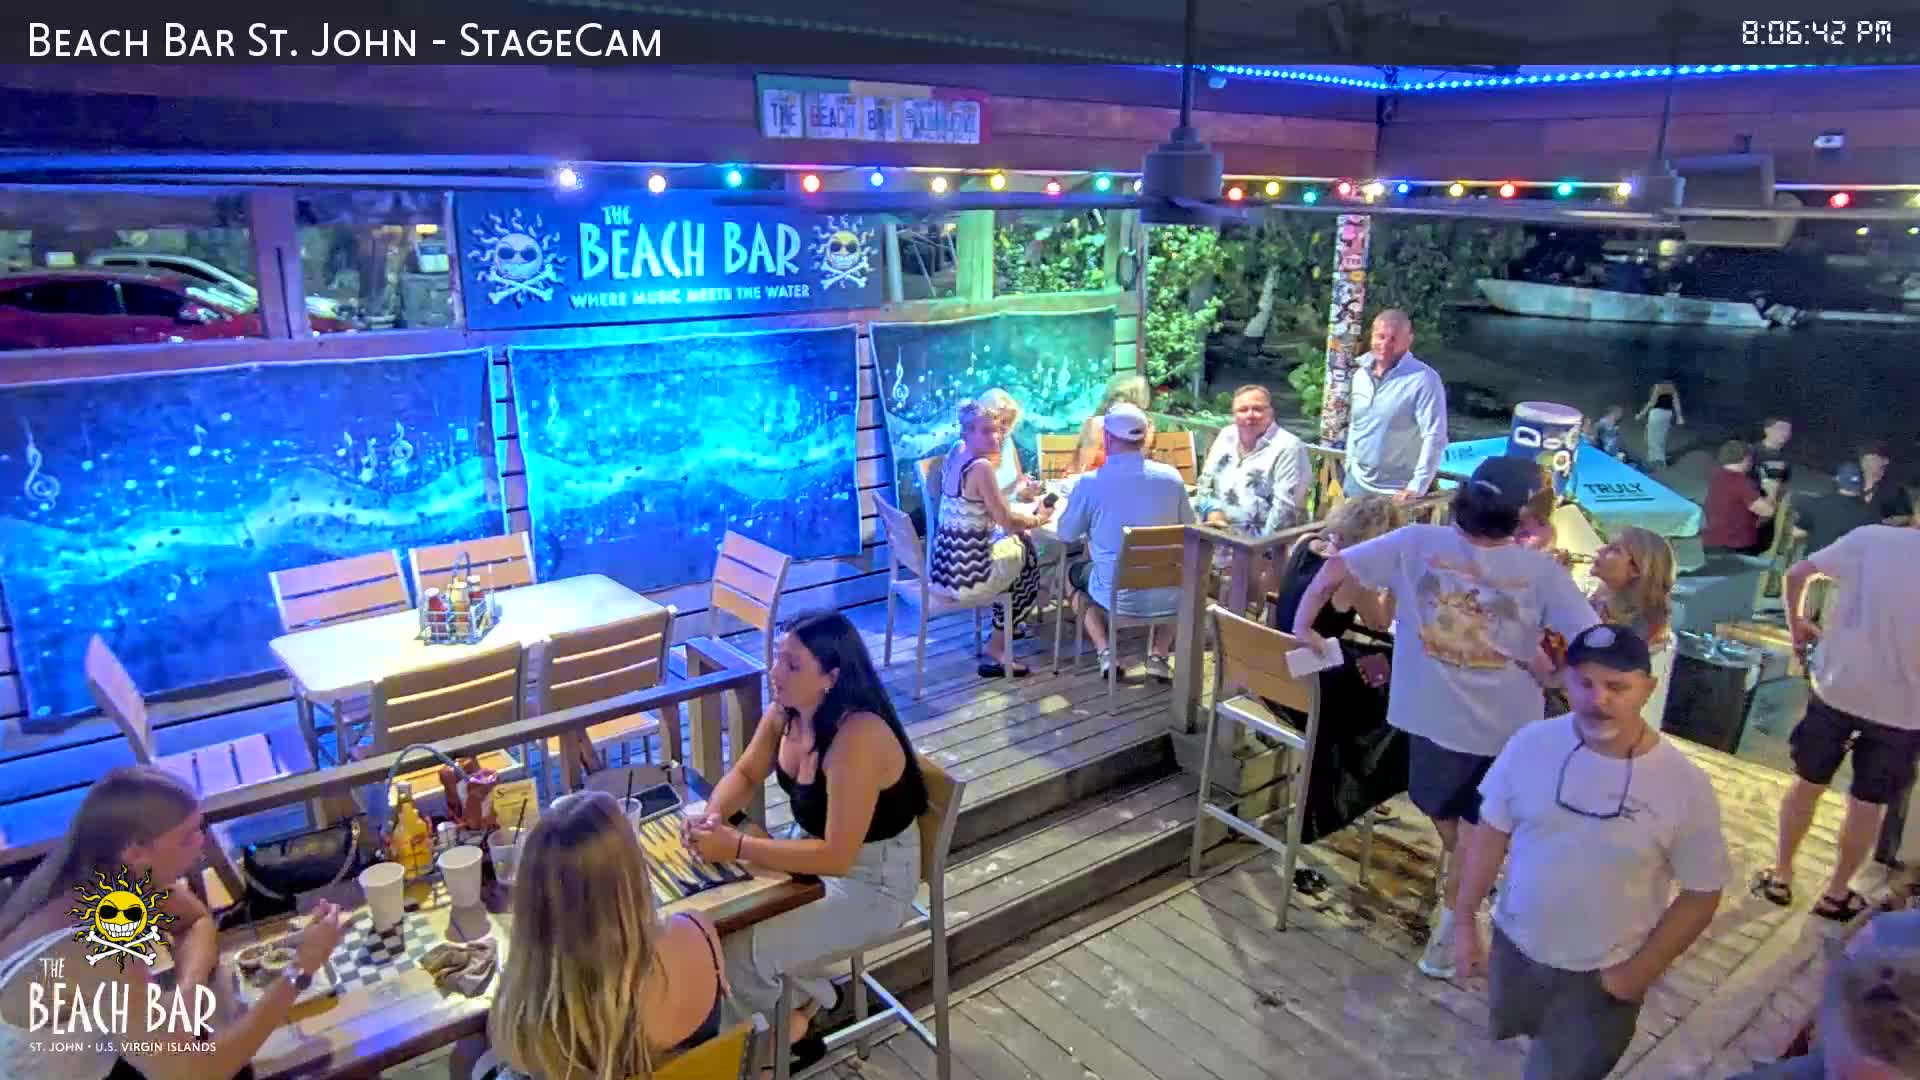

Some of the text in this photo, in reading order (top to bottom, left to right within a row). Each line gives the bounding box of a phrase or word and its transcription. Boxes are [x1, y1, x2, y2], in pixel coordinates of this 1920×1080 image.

[601, 204, 632, 225] THE
[579, 219, 801, 280] BEACH BAR
[571, 284, 810, 308] WHERE MUSIC MEETS THE WATER
[1583, 482, 1643, 495] TRULY
